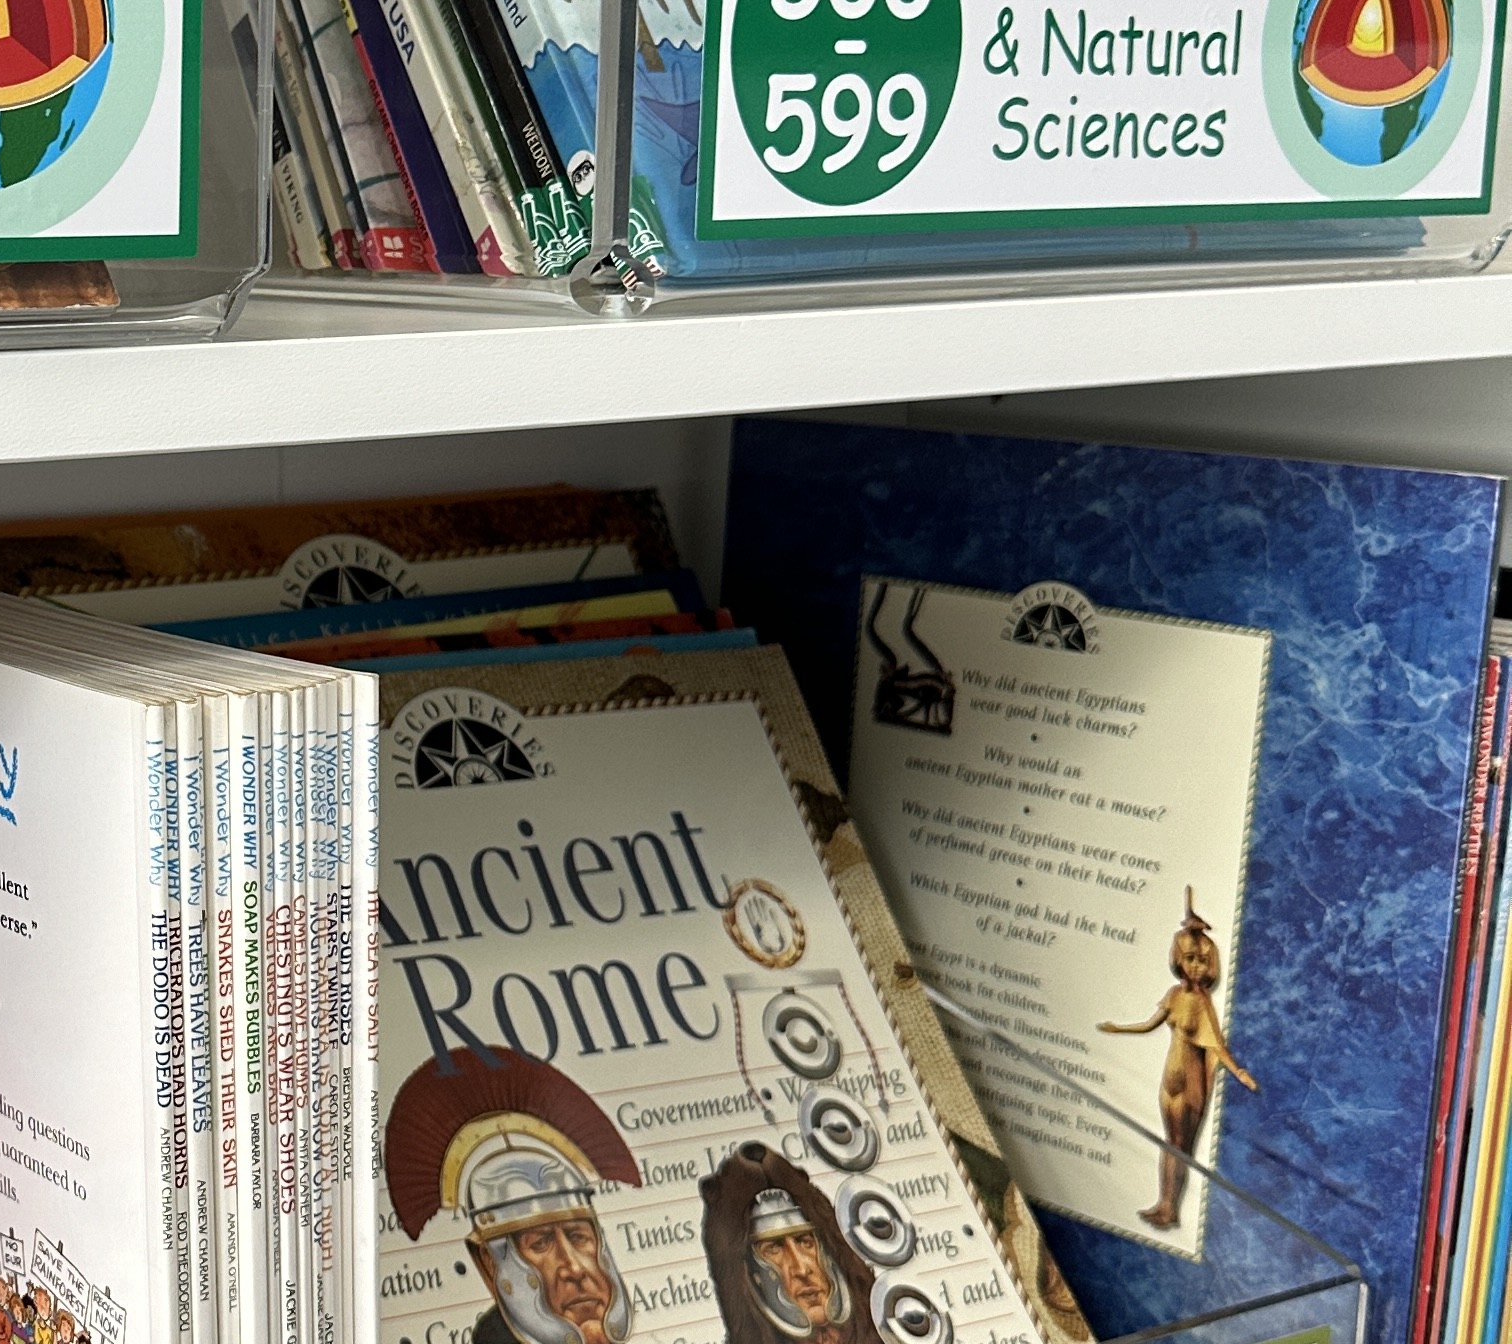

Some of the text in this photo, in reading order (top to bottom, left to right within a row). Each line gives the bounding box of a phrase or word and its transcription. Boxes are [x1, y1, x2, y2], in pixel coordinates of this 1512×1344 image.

[982, 7, 1242, 79] & Natural
[522, 122, 552, 179] WELDON
[763, 72, 926, 175] 599
[992, 95, 1226, 163] Sciences
[962, 668, 1146, 715] Why did ancient Egyptians
[1006, 704, 1138, 739] good luck charms?
[394, 692, 556, 790] DISCOVERIES
[1018, 778, 1166, 822] mother mouse?
[910, 871, 1136, 945] Which had the head
[1096, 870, 1147, 895] heads?
[188, 921, 204, 986] TREES
[327, 893, 339, 957] STARS
[148, 753, 174, 1250] Wonder Why THE DODO IS DEAD ANDREW CHARMAN
[242, 745, 262, 1210] WONDER WHY SOAP MAKES BUBBLES BARBARA TAYLOR
[275, 905, 293, 1047] CHESTNUTS
[293, 895, 309, 1108] CAMELS HAVE HUMPS
[190, 993, 205, 1050] HAVE
[393, 951, 720, 1078] Rome
[218, 910, 238, 1189] SNAKES SHED THEIR SKIN
[191, 1056, 207, 1133] LEAVES
[278, 1057, 294, 1123] WEAR
[616, 1090, 756, 1133] Government
[28, 1115, 90, 1161] questions
[168, 914, 190, 1331] TRICERATOPS HAD HORNS THEODOROU
[280, 1134, 296, 1214] SHOES
[196, 1180, 208, 1234] ANDREW
[617, 1213, 695, 1252] Tunics
[34, 1256, 86, 1318] RAINFOREST
[38, 1240, 85, 1295] SAVE THE
[198, 1239, 209, 1302] CHARMAN
[95, 1309, 118, 1340] NOW
[285, 1280, 297, 1331] JACKIE
